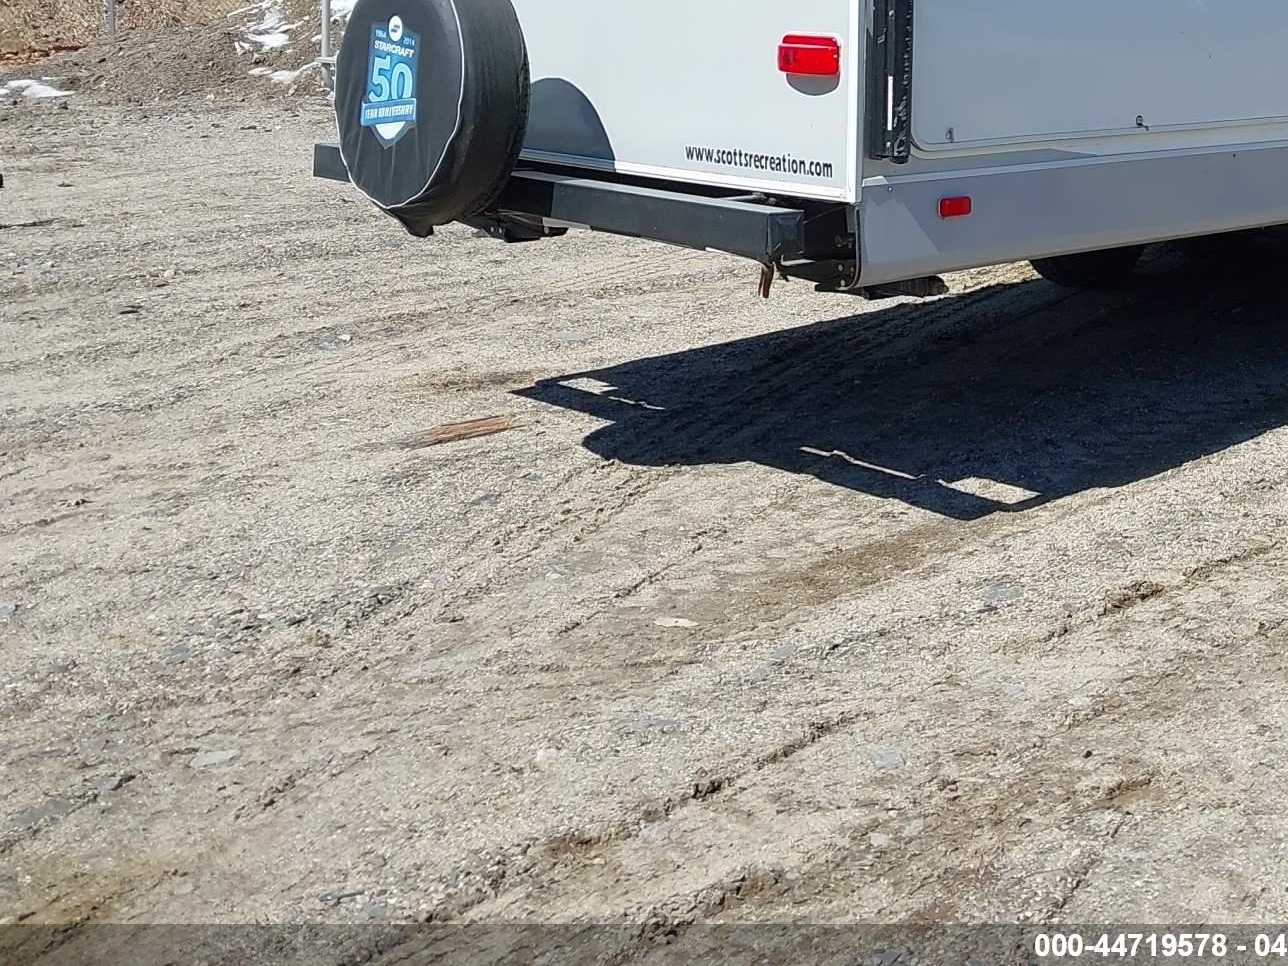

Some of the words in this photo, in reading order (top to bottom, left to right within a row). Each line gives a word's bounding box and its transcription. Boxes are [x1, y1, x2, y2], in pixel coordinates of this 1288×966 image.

[374, 40, 415, 58] STARCRAFT
[368, 54, 413, 103] 50
[685, 146, 833, 178] www.scottsrecreation.com
